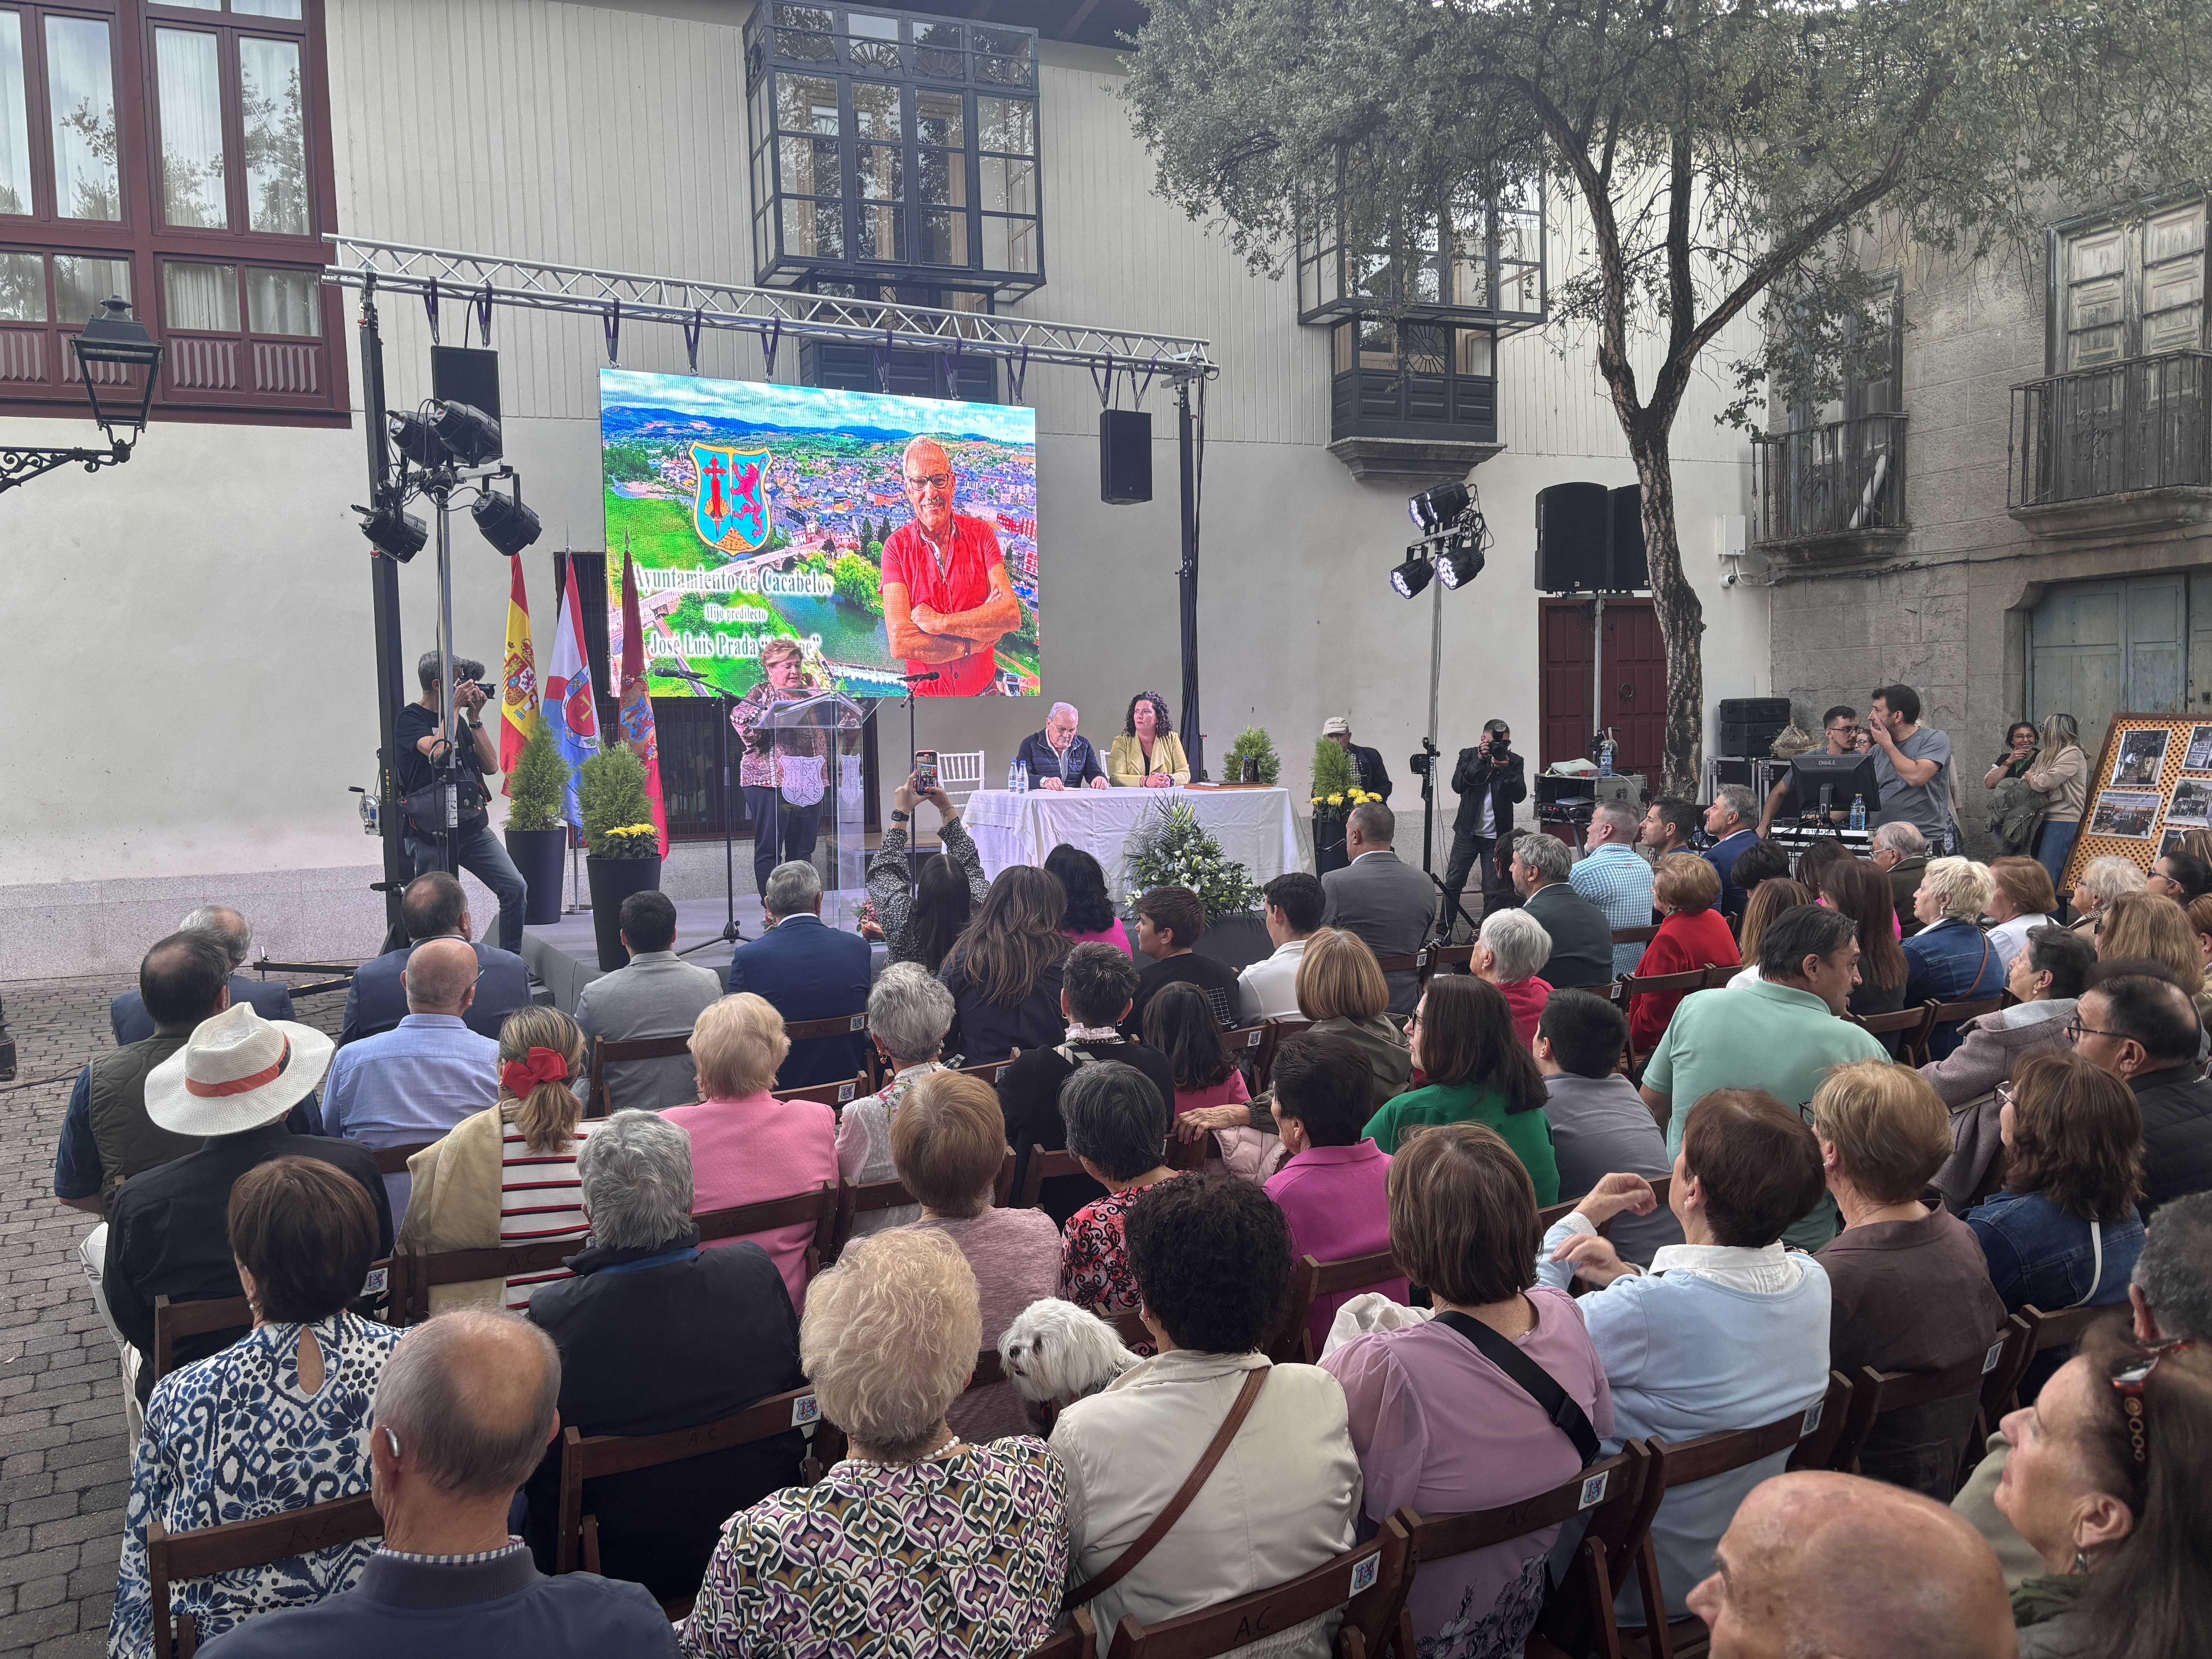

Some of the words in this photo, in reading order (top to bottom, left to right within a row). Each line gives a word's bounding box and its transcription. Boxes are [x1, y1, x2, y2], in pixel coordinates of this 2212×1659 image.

[634, 565, 735, 592] Ayuntamiento
[741, 569, 757, 590] de
[763, 569, 832, 593] Cacabelos
[706, 606, 724, 620] Hijo
[726, 606, 766, 621] predilecto
[651, 633, 680, 655] José
[685, 634, 713, 654] Luis
[718, 635, 756, 655] Prada
[1233, 1605, 1272, 1642] A.C.
